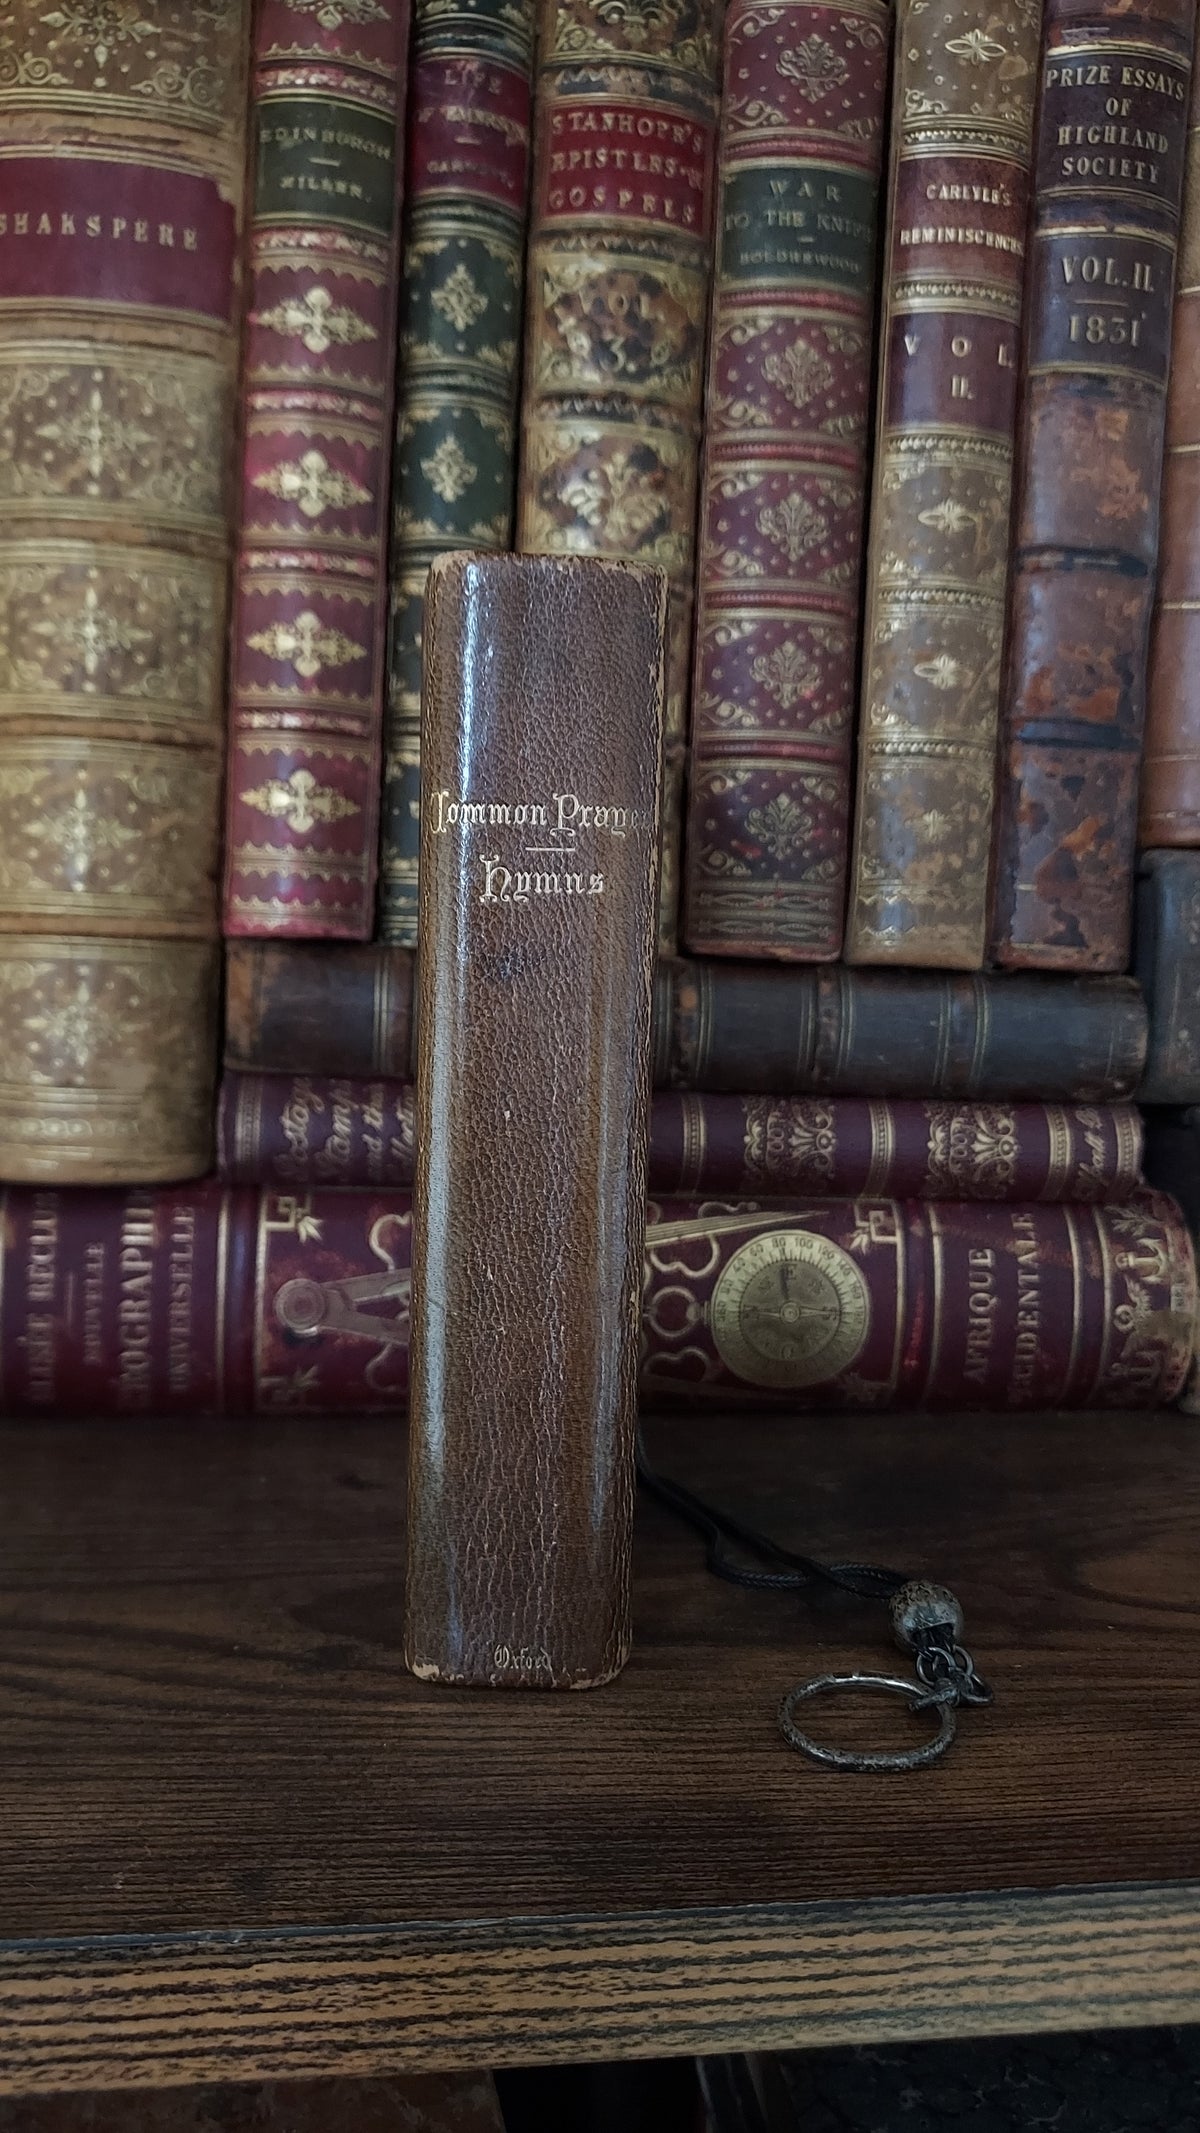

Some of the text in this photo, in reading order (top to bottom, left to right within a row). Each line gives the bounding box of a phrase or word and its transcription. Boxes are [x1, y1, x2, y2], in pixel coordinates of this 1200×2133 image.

[1046, 65, 1185, 101] PRIZE ESSAYS
[1105, 97, 1132, 116] OF
[259, 127, 391, 160] EDINBURGH
[1057, 124, 1169, 154] HIGHLAND
[1061, 156, 1160, 184] SOCIETY
[550, 185, 696, 225] GOSPELS
[769, 179, 842, 202] WAR
[926, 183, 1013, 207] CARLYLE'S
[724, 208, 873, 244] TO THE KNIFE
[900, 226, 1025, 258] REMINISCENCES
[1069, 313, 1141, 348] 1831
[479, 852, 604, 903] Hymns
[963, 1248, 998, 1384] AFRIQUE
